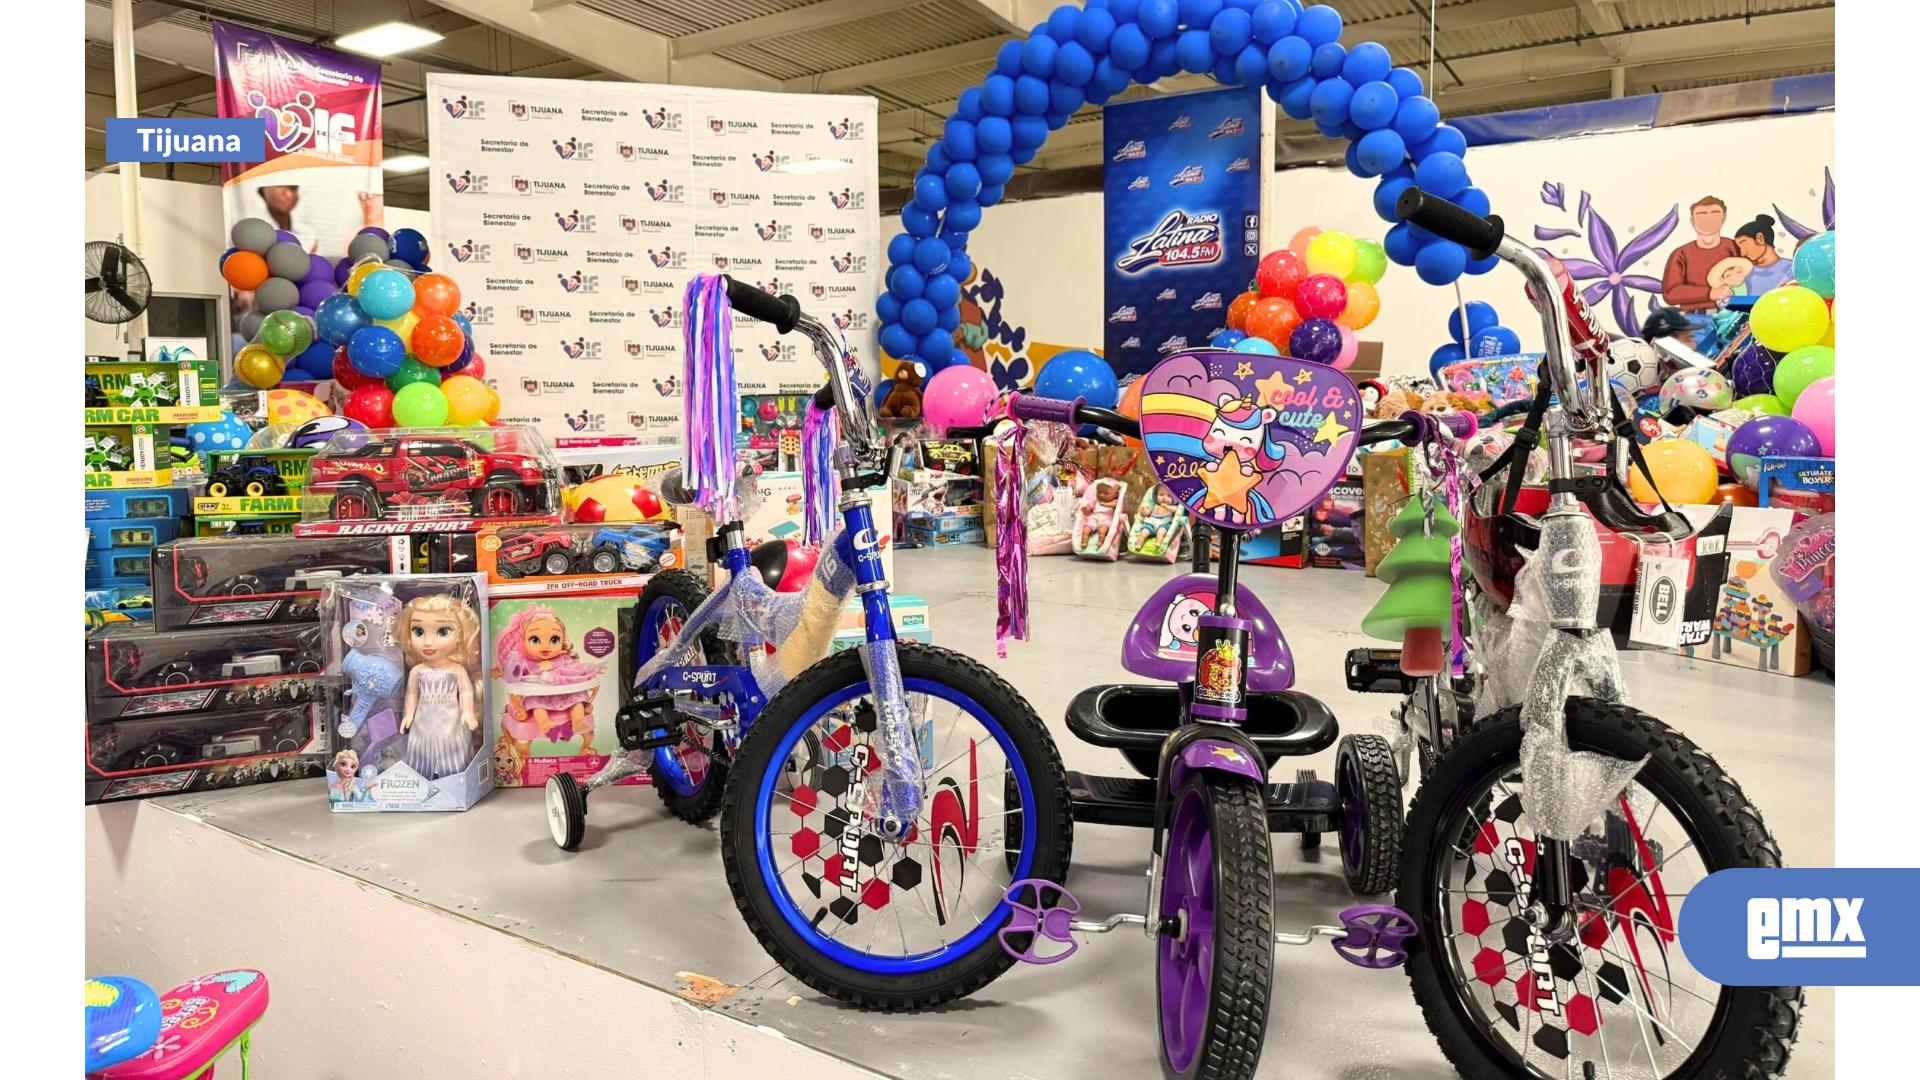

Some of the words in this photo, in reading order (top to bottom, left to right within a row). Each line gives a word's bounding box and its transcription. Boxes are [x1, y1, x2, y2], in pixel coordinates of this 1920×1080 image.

[530, 106, 563, 115] TIJUANA
[771, 128, 801, 136] Bienestar
[638, 148, 669, 156] TIJUANA
[692, 160, 723, 168] Bienestar
[534, 181, 566, 189] TIJUANA
[584, 189, 616, 197] Bienestar
[640, 220, 672, 228] TIJUANA
[1187, 213, 1218, 225] RADIO
[1118, 211, 1218, 269] Latina
[536, 249, 569, 257] TIJUANA
[1165, 247, 1200, 261] 104.5
[1200, 247, 1215, 256] FM
[1270, 385, 1318, 408] cool
[1322, 387, 1344, 409] &
[117, 408, 160, 422] CAR
[1279, 408, 1326, 428] cute
[240, 498, 293, 511] FARM
[338, 524, 408, 536] RACING
[410, 520, 474, 532] SPORT
[562, 580, 598, 588] OFF-ROAD
[1656, 584, 1670, 617] BELL
[682, 672, 717, 683] C-SPORT
[380, 779, 420, 789] FROZEN
[840, 743, 870, 893] C-SPORT
